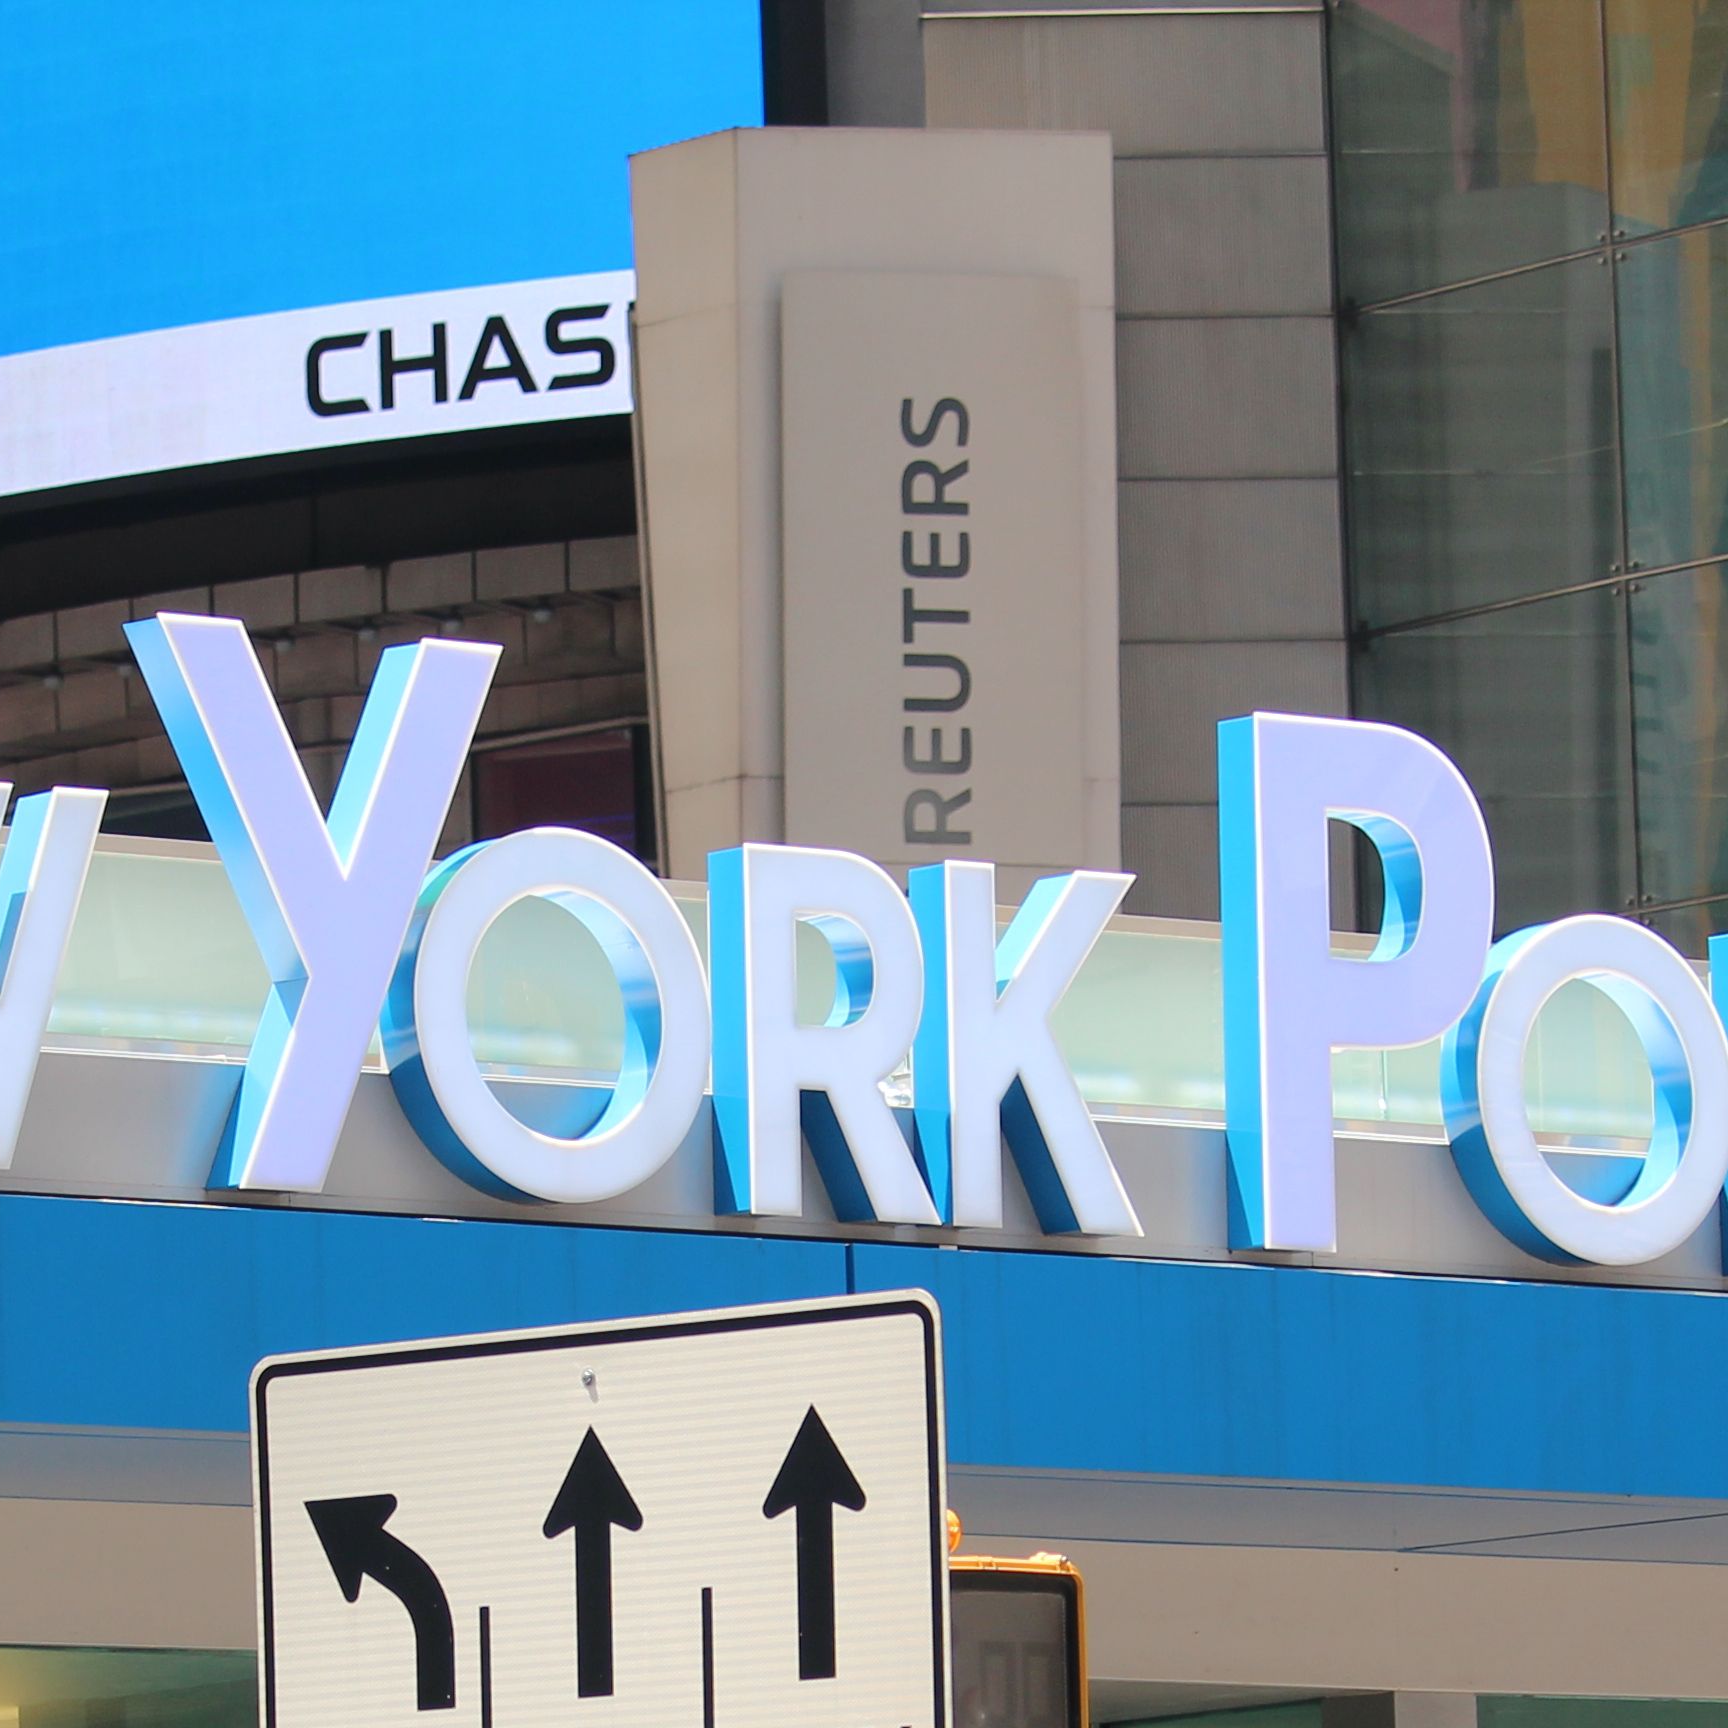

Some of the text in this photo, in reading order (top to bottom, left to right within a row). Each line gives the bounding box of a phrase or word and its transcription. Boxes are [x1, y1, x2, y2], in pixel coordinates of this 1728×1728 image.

[306, 302, 634, 418] CHAS
[901, 396, 974, 845] REUTERS
[125, 611, 1144, 1240] YORK
